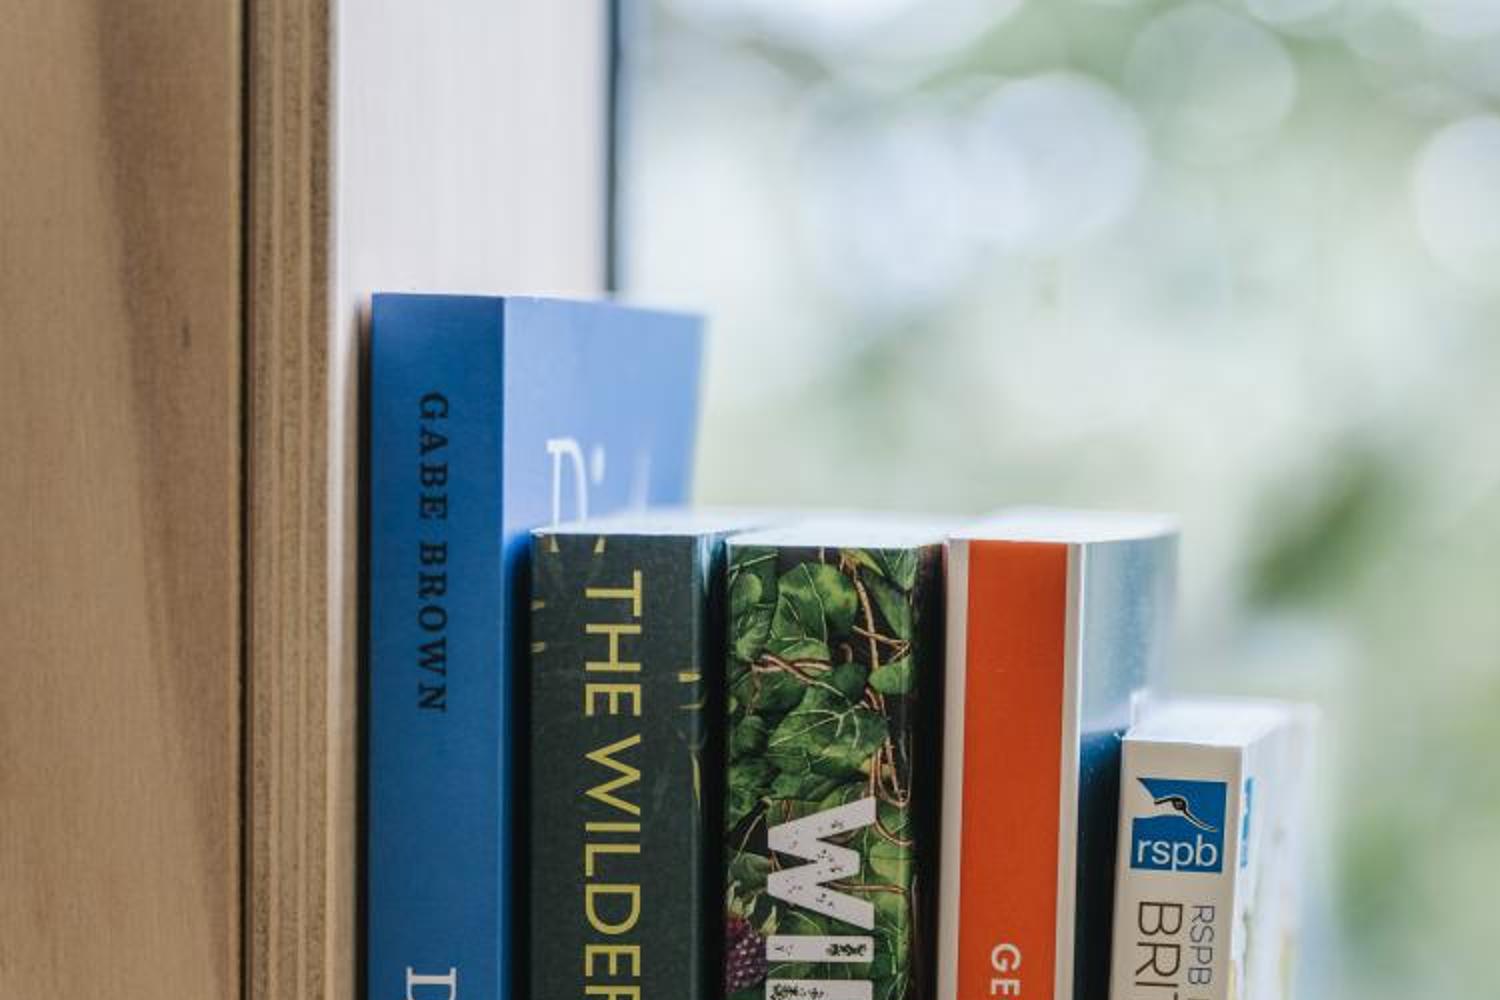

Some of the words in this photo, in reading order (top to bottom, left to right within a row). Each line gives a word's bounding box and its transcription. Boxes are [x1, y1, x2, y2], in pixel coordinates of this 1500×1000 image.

[417, 390, 449, 521] GABE
[416, 541, 448, 713] BROWN
[584, 568, 643, 717] THE
[1136, 833, 1218, 873] rspb
[1187, 904, 1216, 985] RSPB
